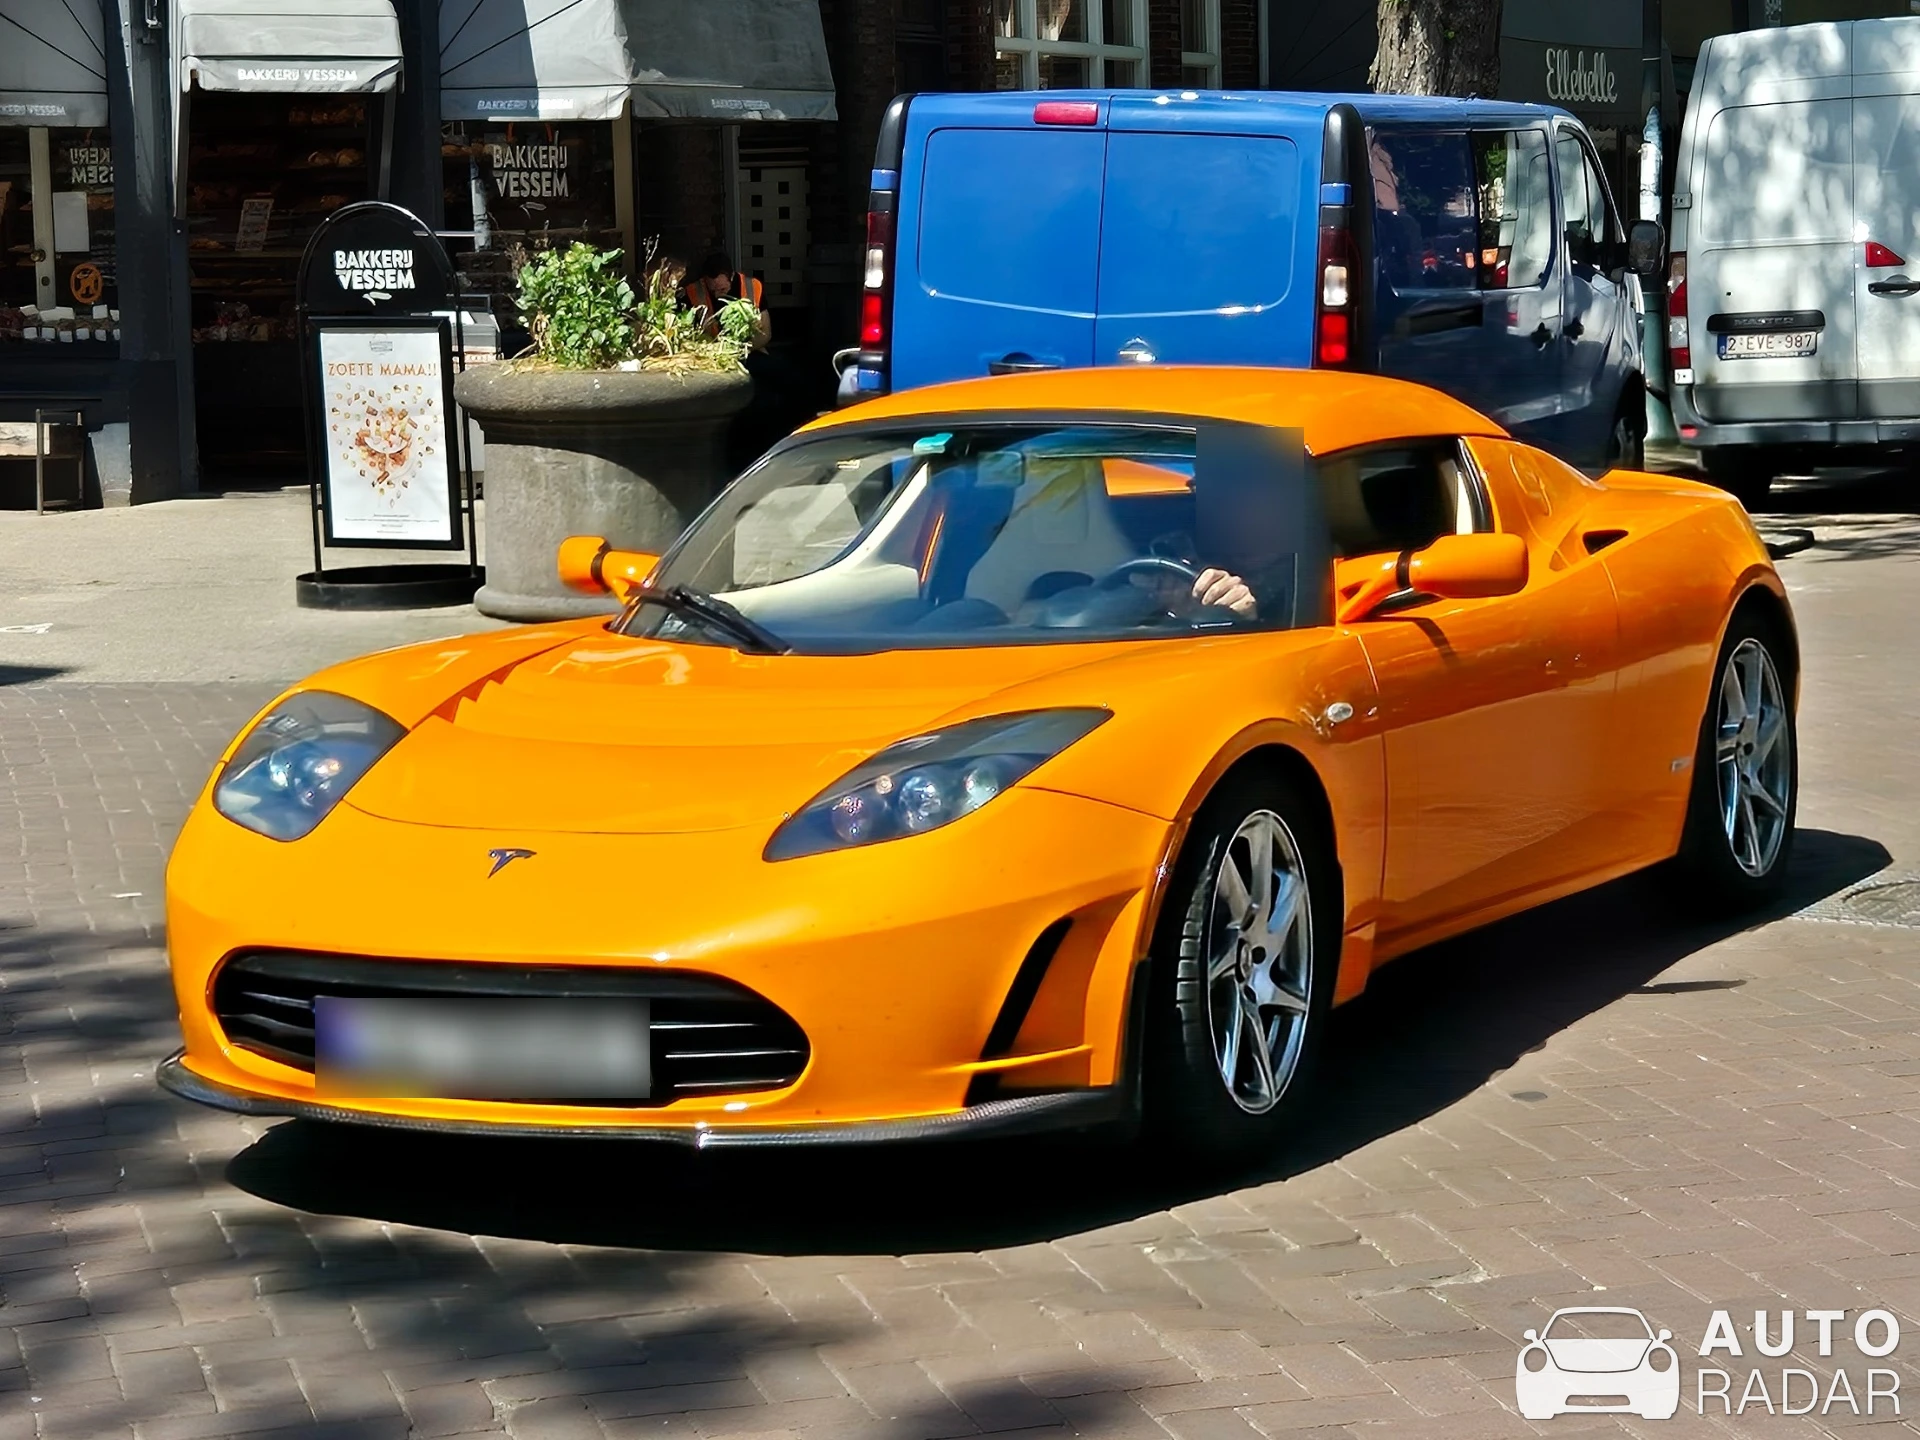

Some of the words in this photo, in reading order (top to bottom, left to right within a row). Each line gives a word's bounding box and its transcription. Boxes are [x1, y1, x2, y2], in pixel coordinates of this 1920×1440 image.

[237, 69, 299, 81] BAKKERIJ
[303, 69, 358, 81] VESSEM
[493, 145, 568, 168] BAKKERIJ
[495, 171, 569, 197] VESSEM
[334, 250, 413, 269] BAKKERIJ
[337, 269, 415, 290] VESSEM
[328, 363, 374, 376] ZOETE
[379, 363, 437, 376] MAMA!!
